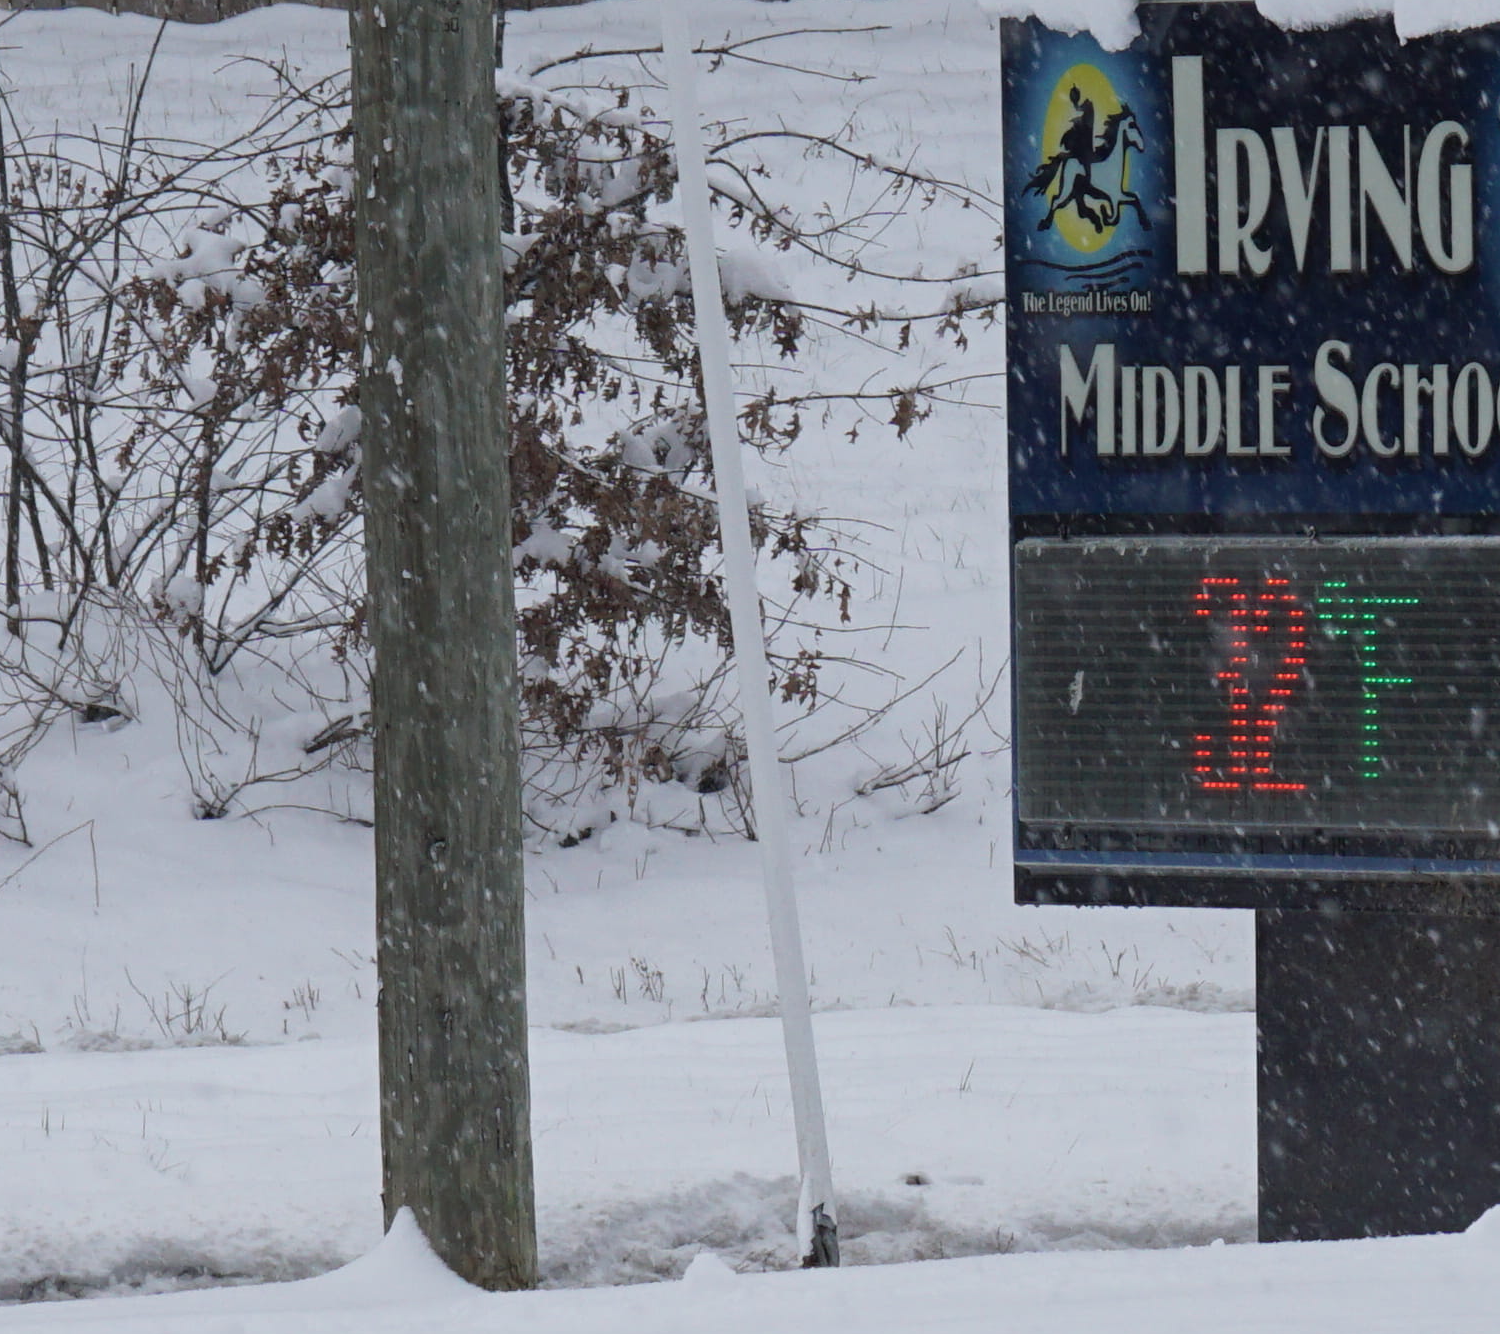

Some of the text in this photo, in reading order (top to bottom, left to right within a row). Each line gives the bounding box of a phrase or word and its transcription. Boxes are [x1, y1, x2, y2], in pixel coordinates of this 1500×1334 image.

[1172, 55, 1473, 276] IRVING
[1022, 290, 1151, 317] The Legend Lives On!
[1059, 343, 1291, 456] MIDDLE
